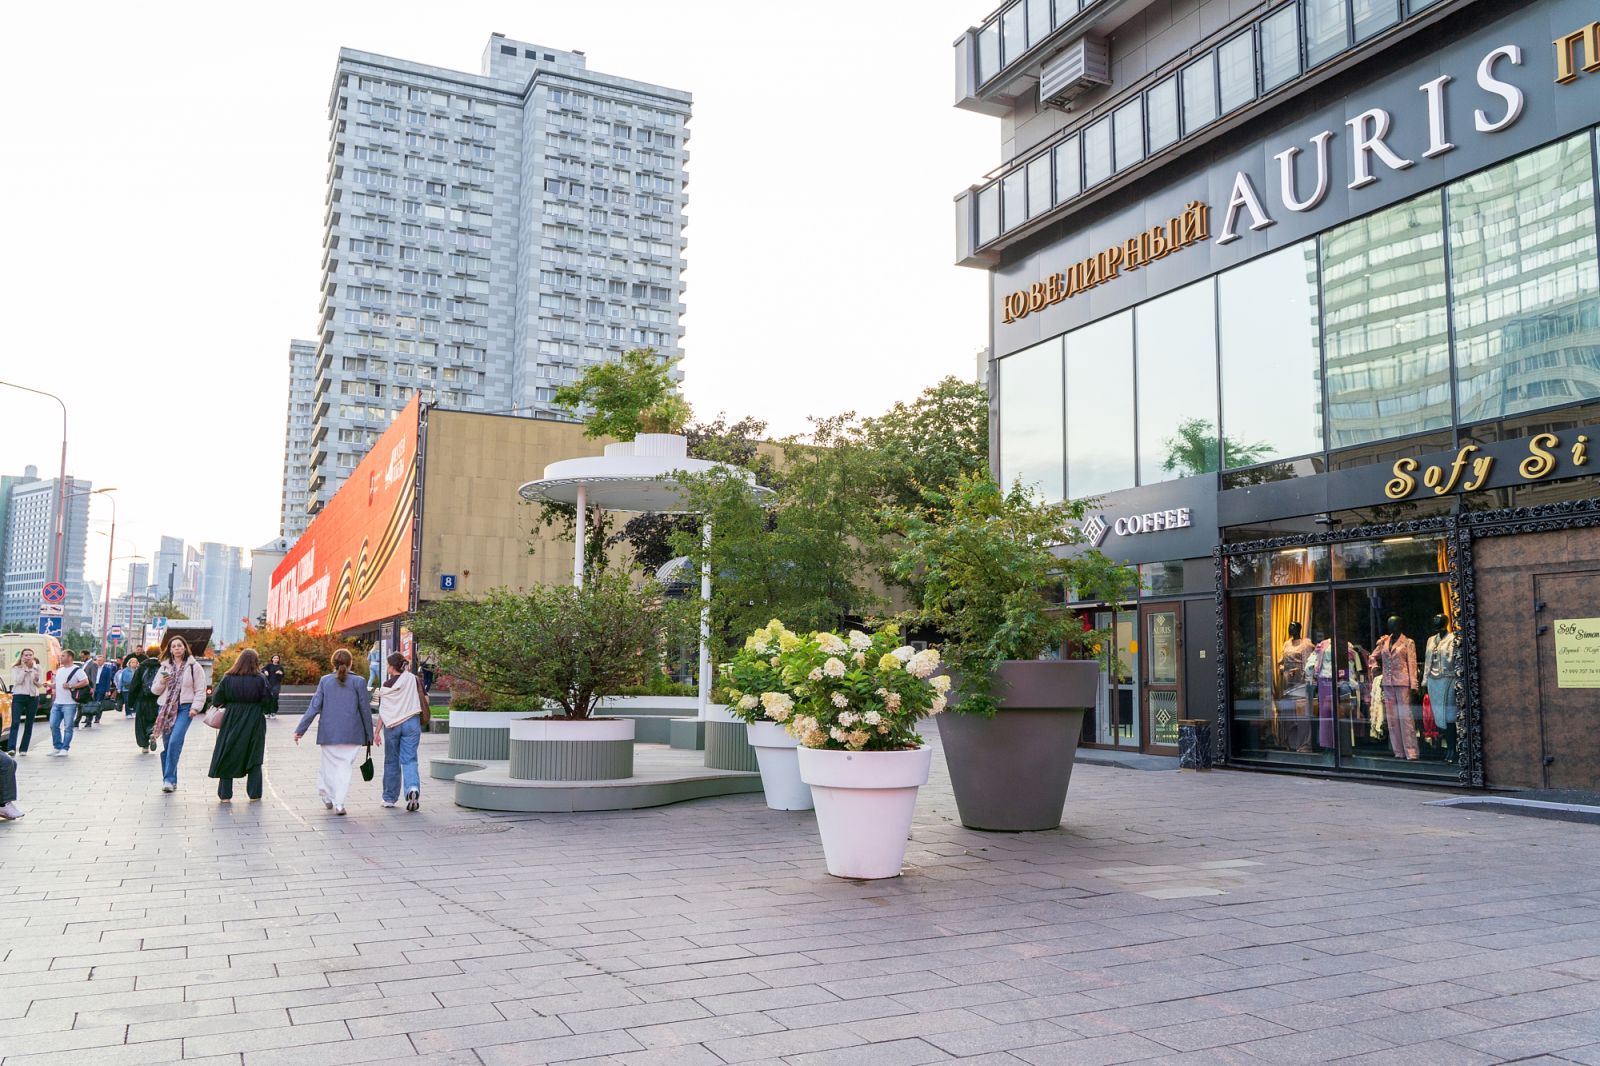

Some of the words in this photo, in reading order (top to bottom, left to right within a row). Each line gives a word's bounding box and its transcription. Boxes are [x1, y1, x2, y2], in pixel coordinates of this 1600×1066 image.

[1216, 44, 1525, 246] AURIS
[1001, 200, 1210, 324] ЮВЕЛИРНЫЙ
[1384, 444, 1495, 499] Sofy
[1114, 507, 1192, 537] COFFEE
[445, 576, 452, 587] 8
